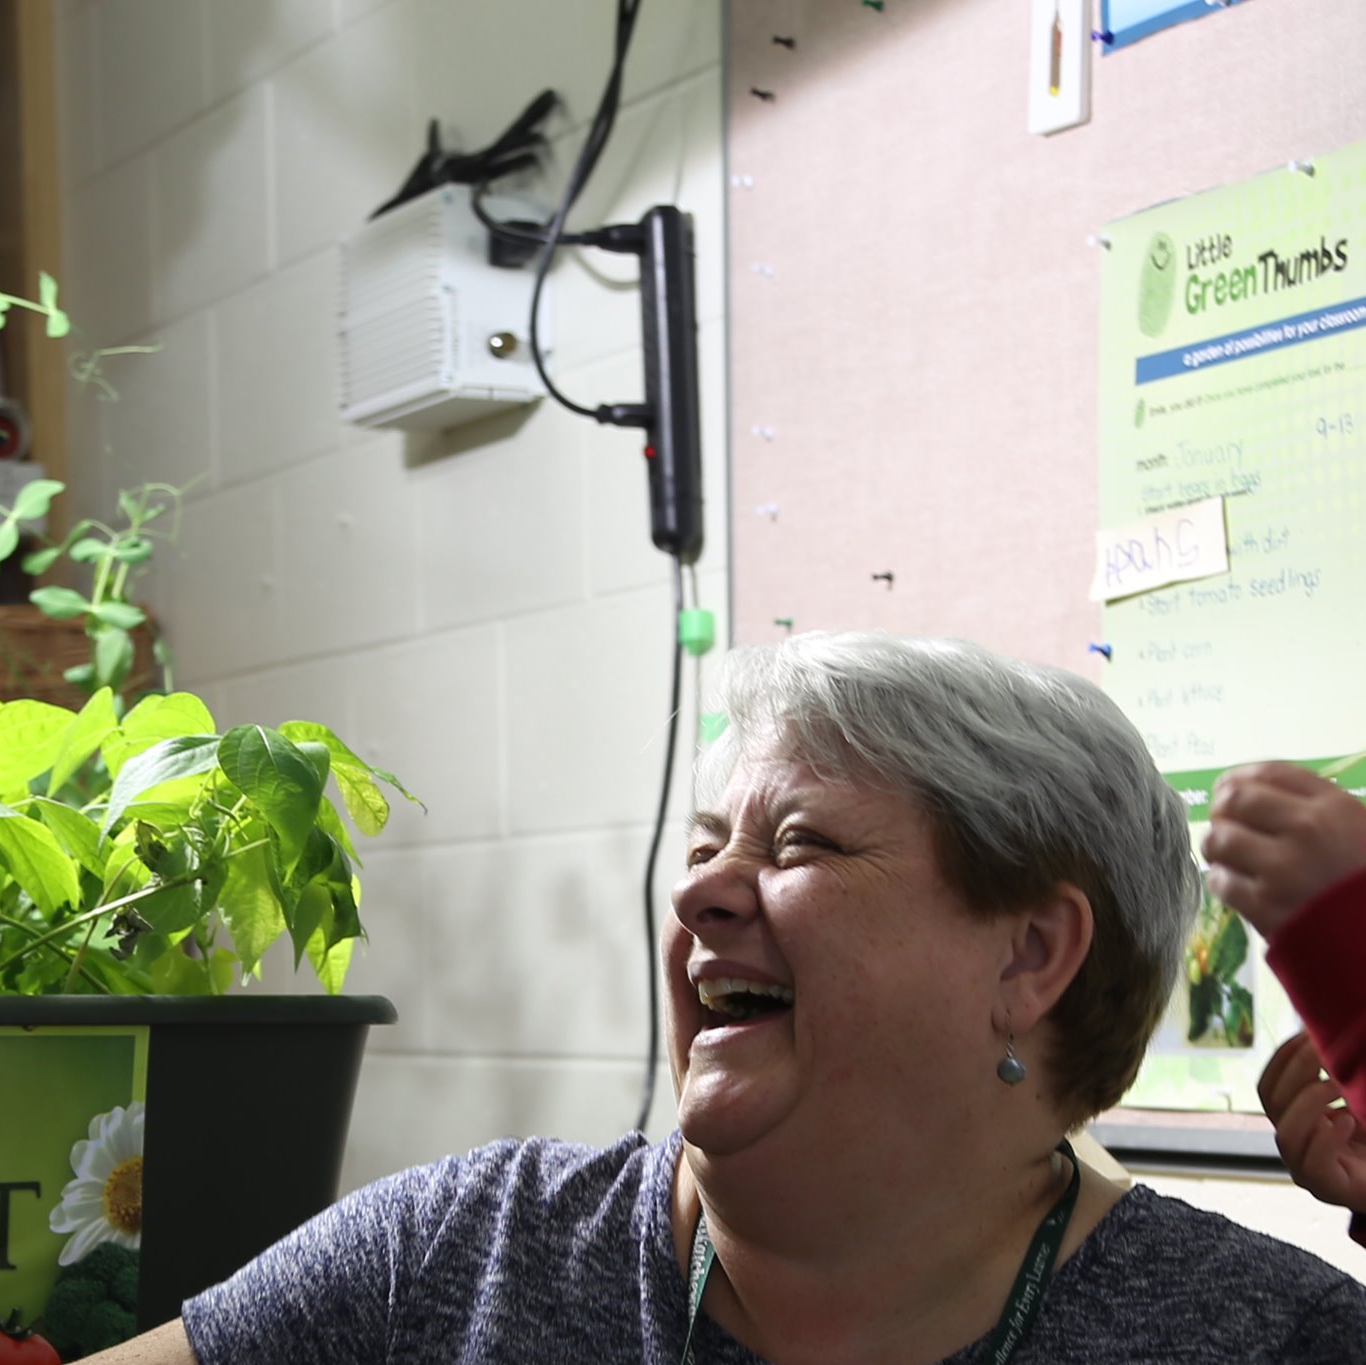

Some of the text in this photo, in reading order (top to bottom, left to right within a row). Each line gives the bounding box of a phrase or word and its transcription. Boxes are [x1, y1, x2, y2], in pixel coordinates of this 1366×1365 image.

[1186, 233, 1234, 271] Little
[1296, 318, 1319, 339] your
[1250, 566, 1323, 598] seedlings
[1008, 1312, 1025, 1335] for
